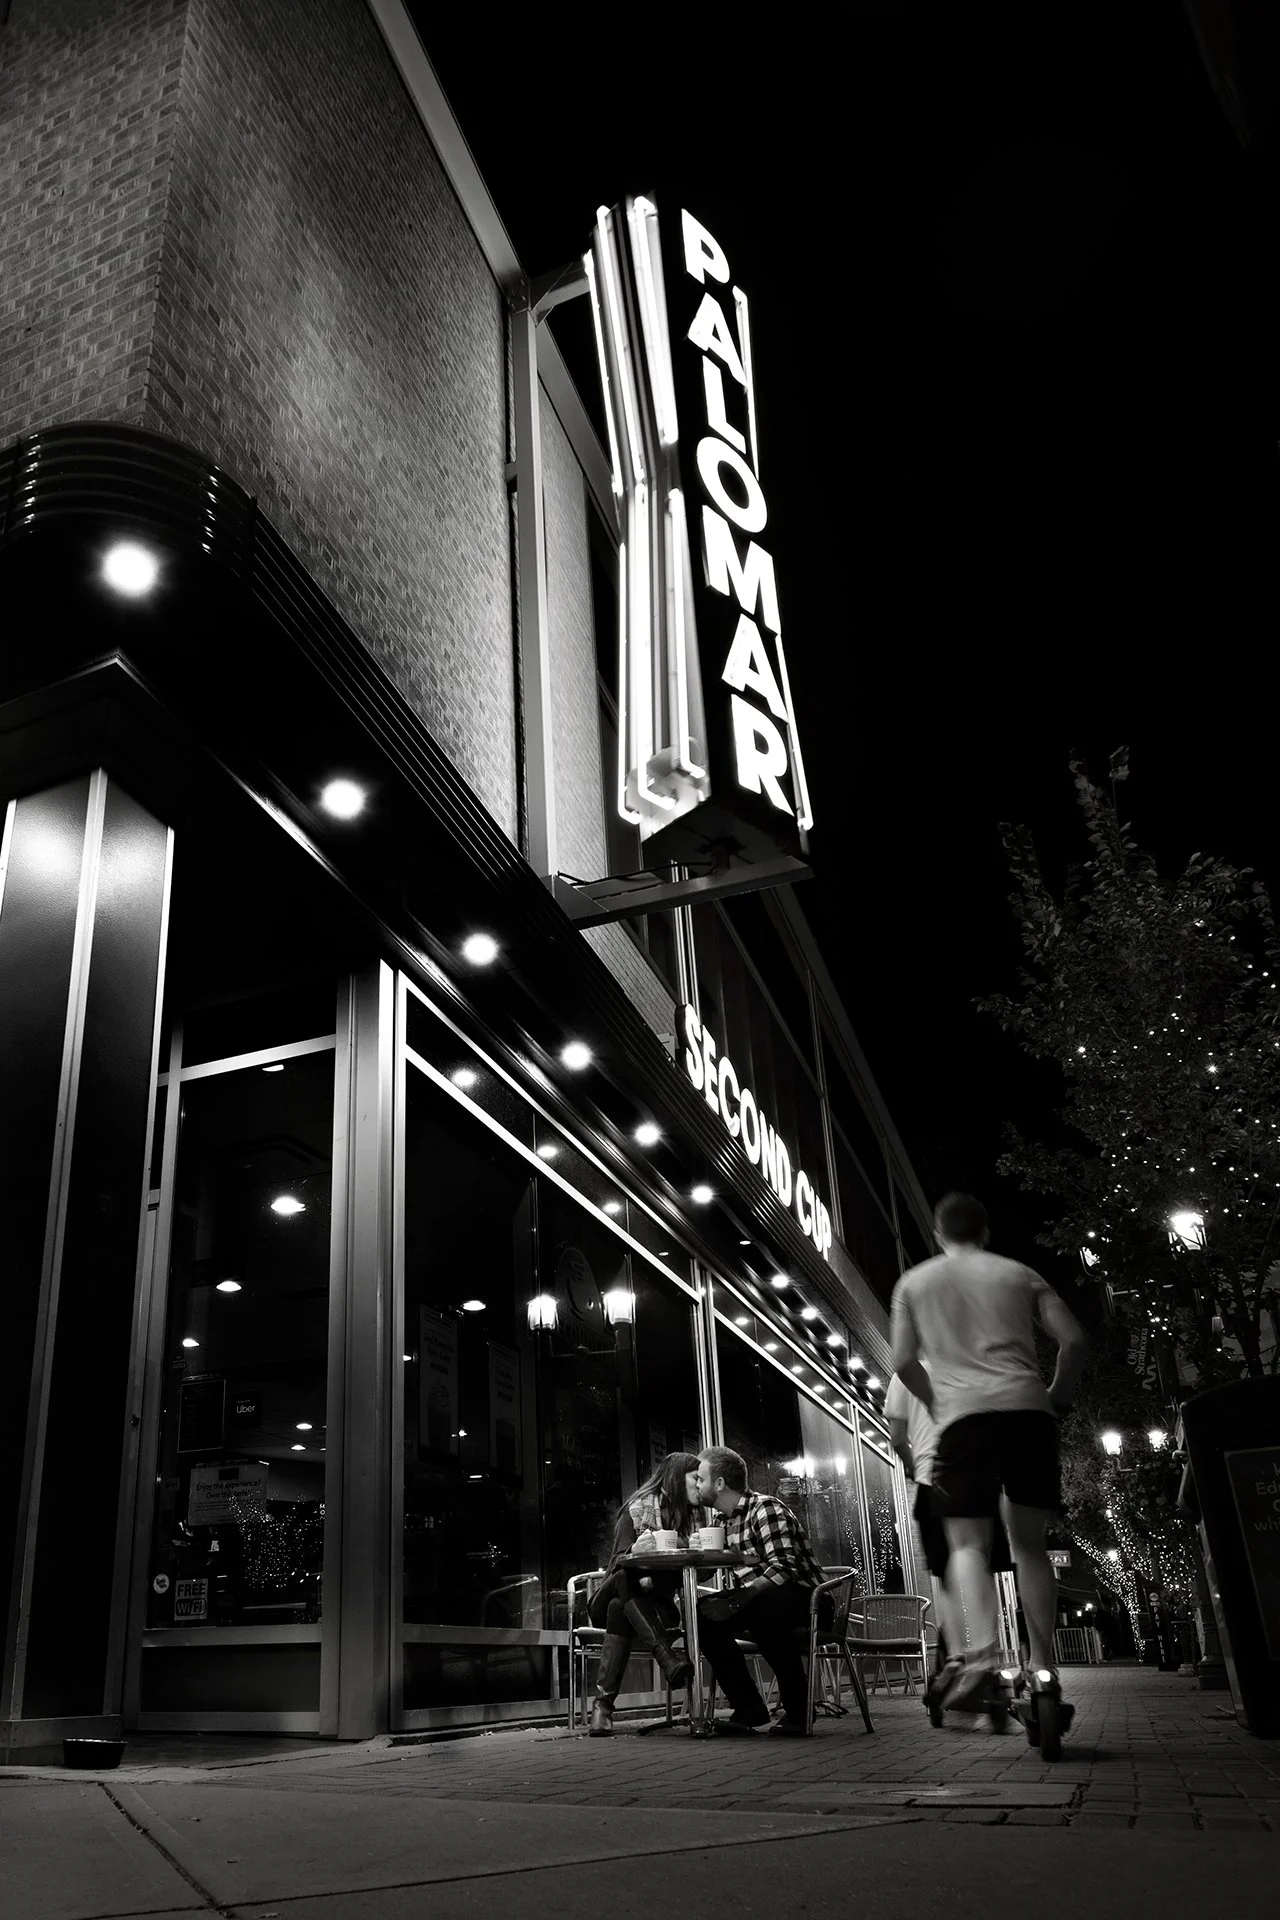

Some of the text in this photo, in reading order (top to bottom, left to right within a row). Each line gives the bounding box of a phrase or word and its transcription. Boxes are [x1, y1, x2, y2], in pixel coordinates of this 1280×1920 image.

[681, 207, 795, 816] PALOMAR
[682, 1003, 832, 1262] SECOND CUP
[236, 1404, 255, 1414] Uber
[177, 1583, 206, 1597] FREE
